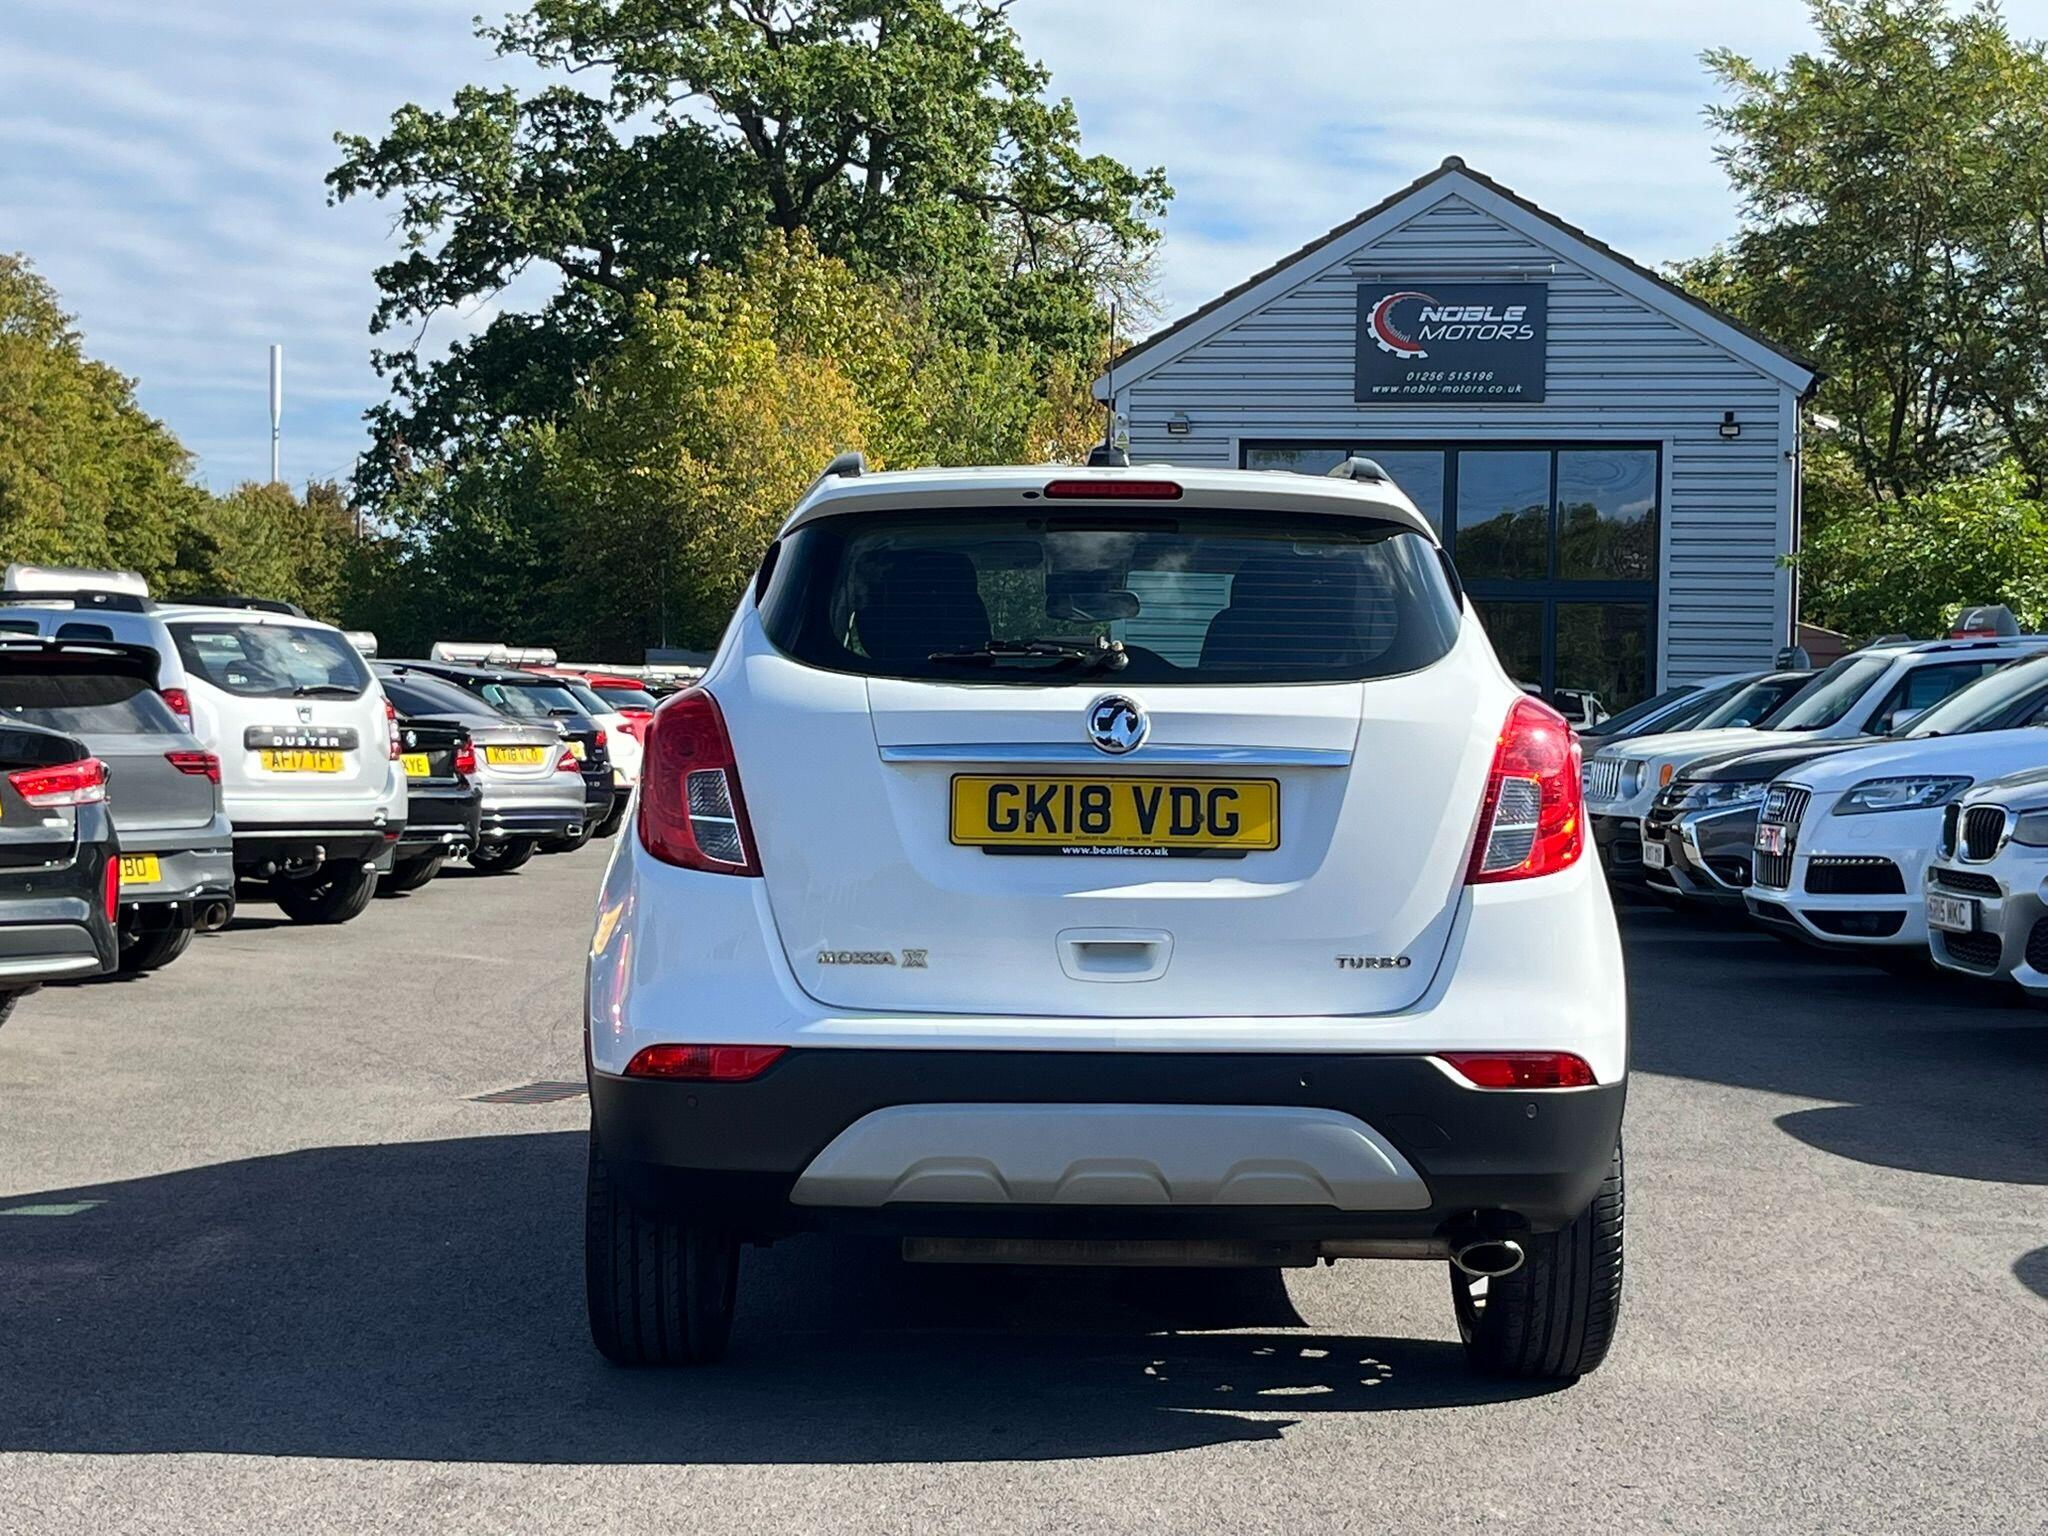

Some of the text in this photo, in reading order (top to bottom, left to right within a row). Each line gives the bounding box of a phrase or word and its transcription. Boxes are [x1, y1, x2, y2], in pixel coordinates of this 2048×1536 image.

[1419, 306, 1527, 322] NOBLE
[1419, 325, 1535, 340] MOTORS
[1406, 371, 1445, 382] 01256
[1372, 384, 1523, 394] www.noble-motors.co.uk
[273, 735, 340, 746] DUSTER
[987, 783, 1240, 836] GK18 VDG
[1061, 845, 1169, 856] www.beadles.co.uk
[817, 949, 928, 968] MOKKA X
[1335, 955, 1412, 969] TURBO
